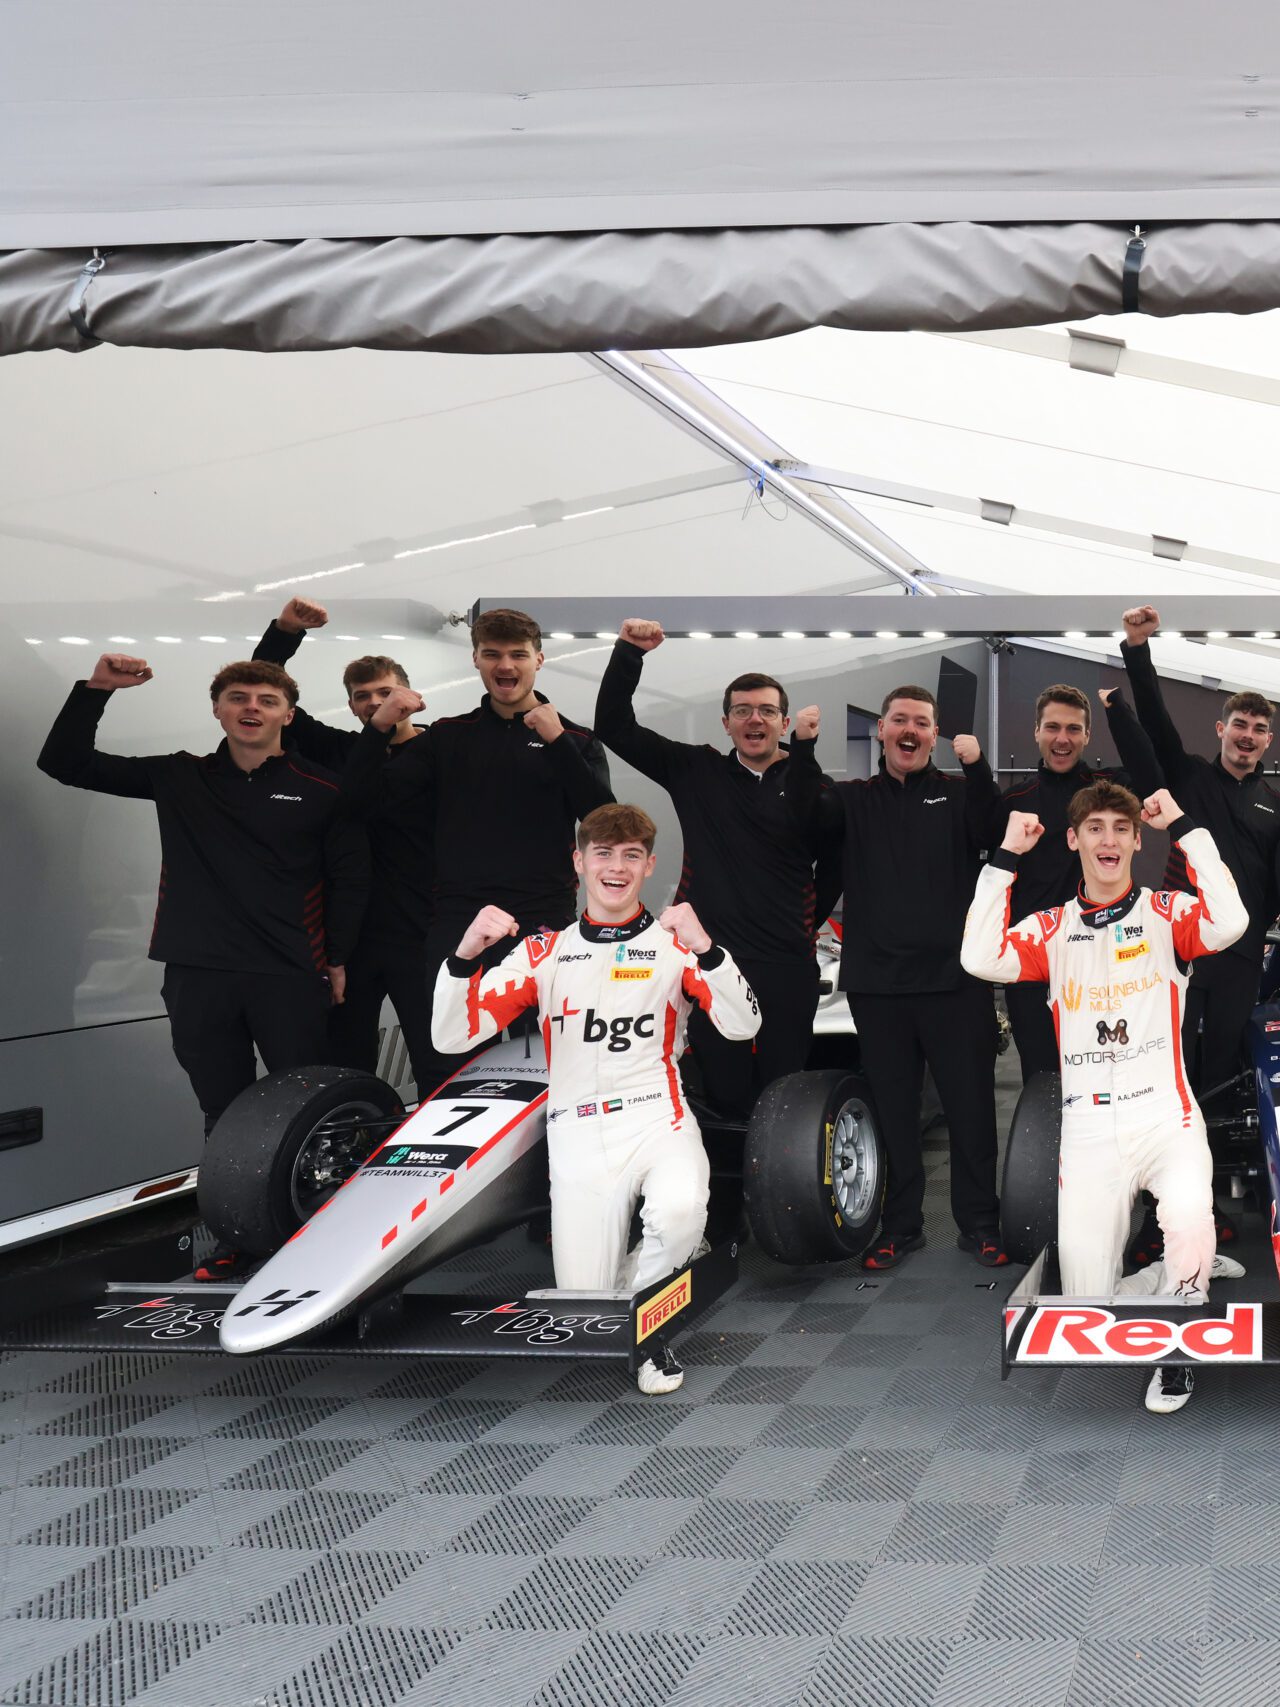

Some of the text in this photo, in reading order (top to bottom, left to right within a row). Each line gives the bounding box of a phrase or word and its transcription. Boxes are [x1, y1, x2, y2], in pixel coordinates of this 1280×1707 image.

[270, 794, 302, 802] Hitech
[1254, 803, 1275, 814] Hitech
[1067, 934, 1095, 943] Hitec
[627, 948, 657, 957] Wera
[614, 970, 651, 979] PIRELLI
[583, 1008, 655, 1053] bgc
[1064, 1037, 1167, 1066] MOTORSCAPE
[480, 1065, 549, 1075] motorsport
[627, 1092, 663, 1105] T.PALMER
[432, 1105, 490, 1137] 7
[406, 1150, 449, 1161] Wera
[359, 1169, 447, 1180] #TEAMWILL37
[641, 1281, 688, 1336] PIRELLI
[493, 1309, 629, 1345] bgc
[1018, 1305, 1260, 1359] Red
